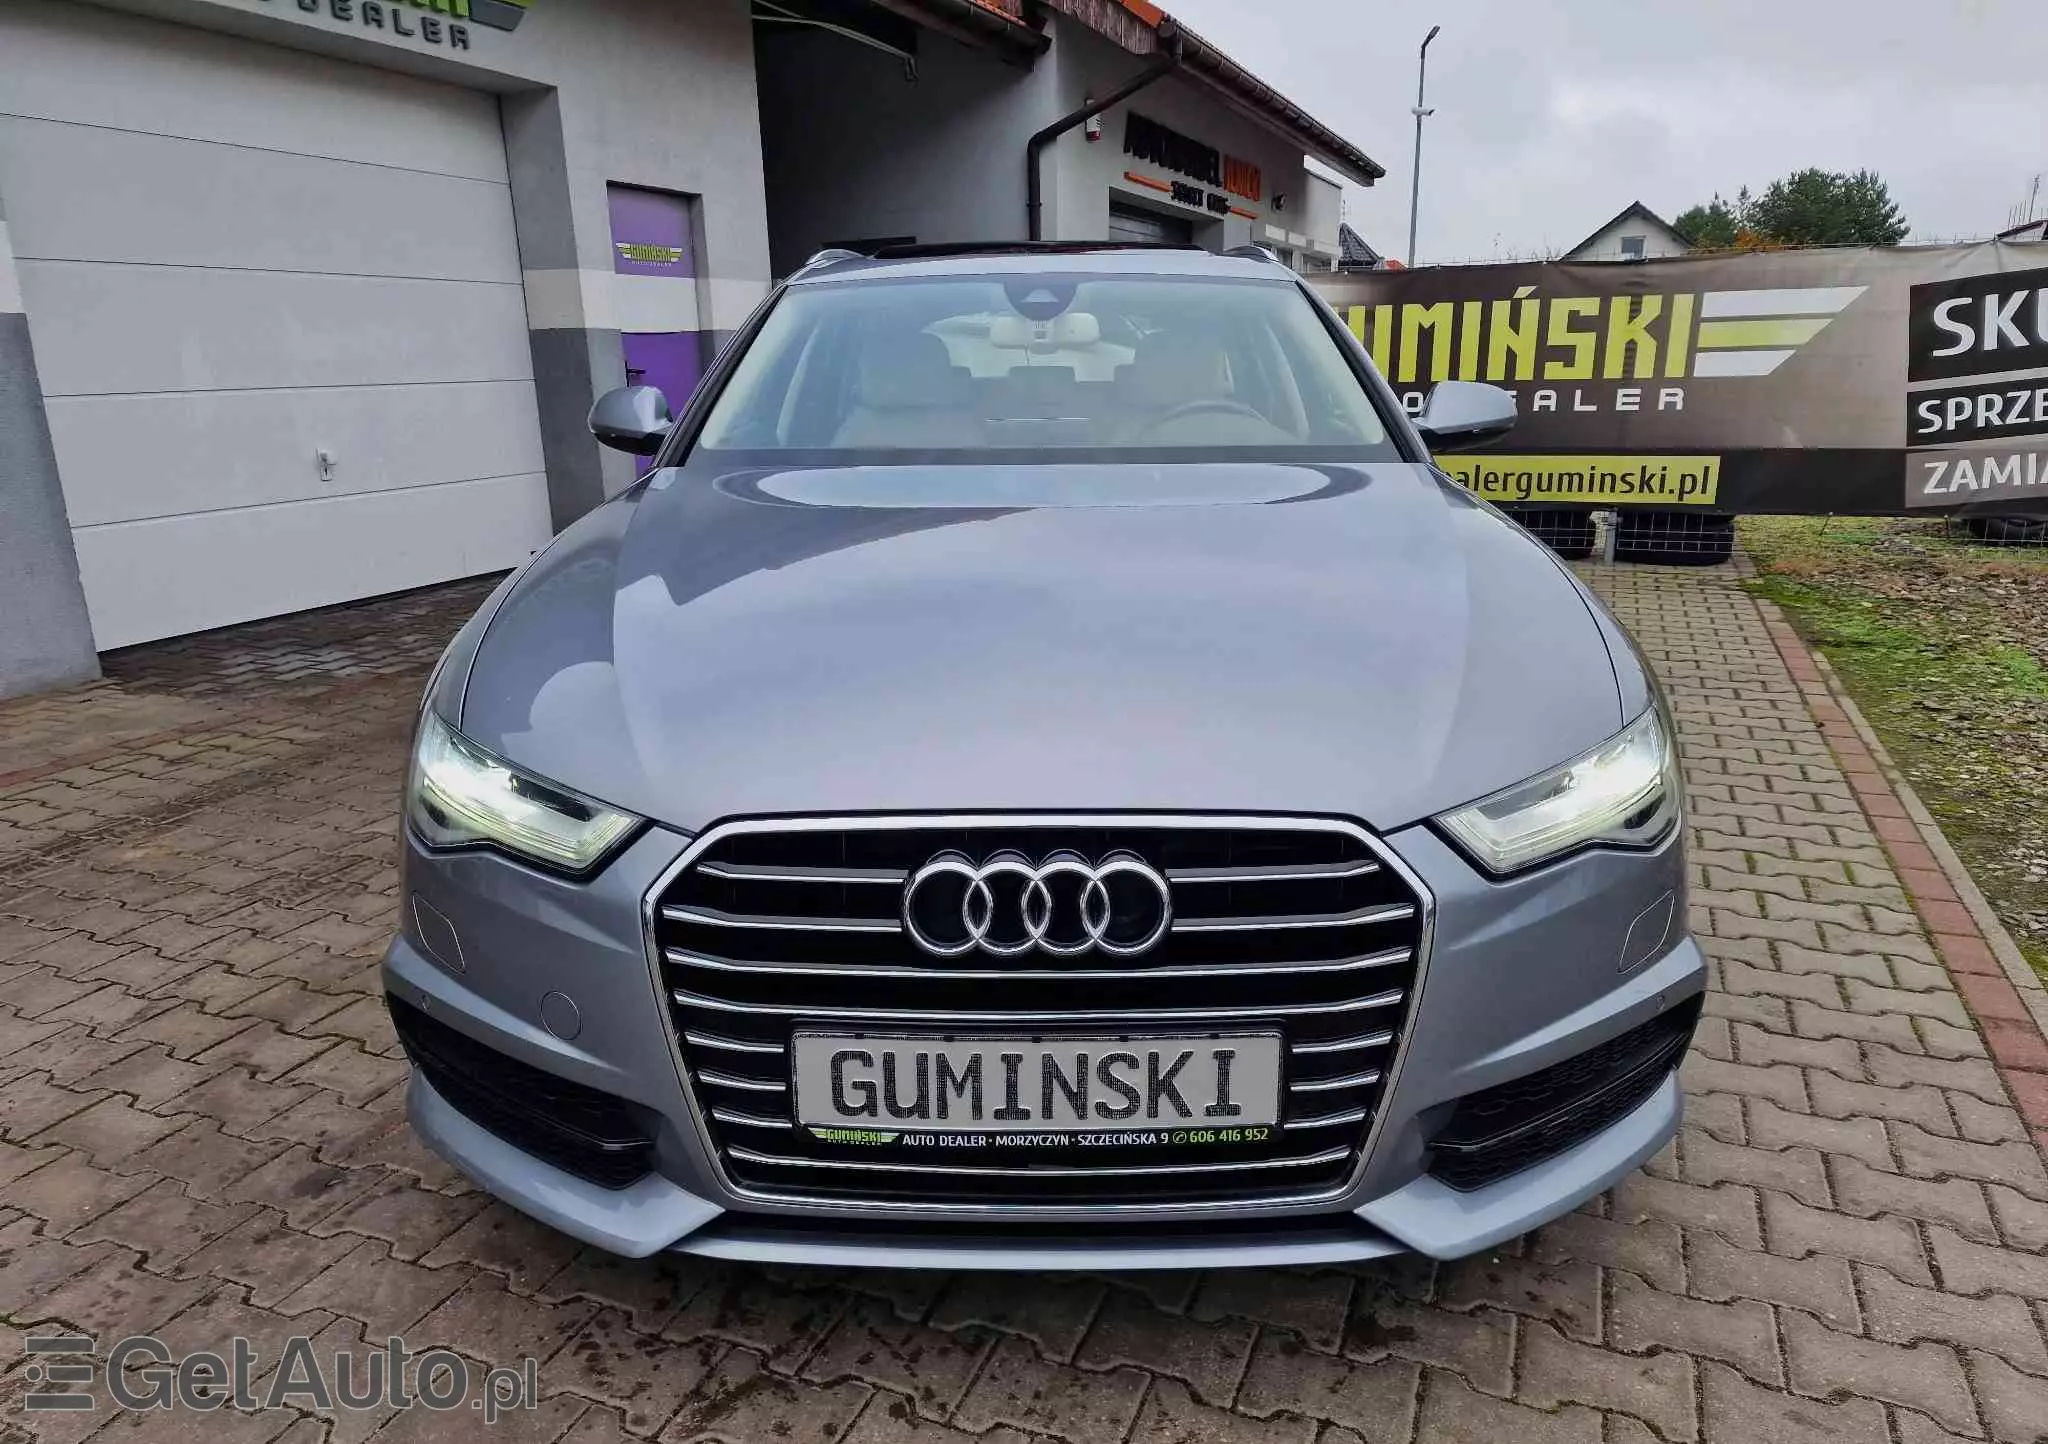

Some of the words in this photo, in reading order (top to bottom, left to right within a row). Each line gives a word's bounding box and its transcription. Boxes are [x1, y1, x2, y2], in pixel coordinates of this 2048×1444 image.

[1333, 286, 1696, 383] UMIŃSKI
[1932, 286, 2048, 357] SK
[1445, 464, 1710, 502] alerguminski.pl
[1923, 453, 2048, 494] ZAMI
[830, 1049, 1242, 1121] GUMINSKI
[903, 1134, 935, 1146] AUTO
[940, 1134, 987, 1147] DEALER
[995, 1135, 1069, 1147] MORZYCZYN
[1077, 1131, 1157, 1145] SZCZECIŃSKA
[1160, 1132, 1169, 1144] 9
[1189, 1130, 1215, 1143] 606
[1219, 1129, 1241, 1142] 416
[1245, 1127, 1269, 1141] 952
